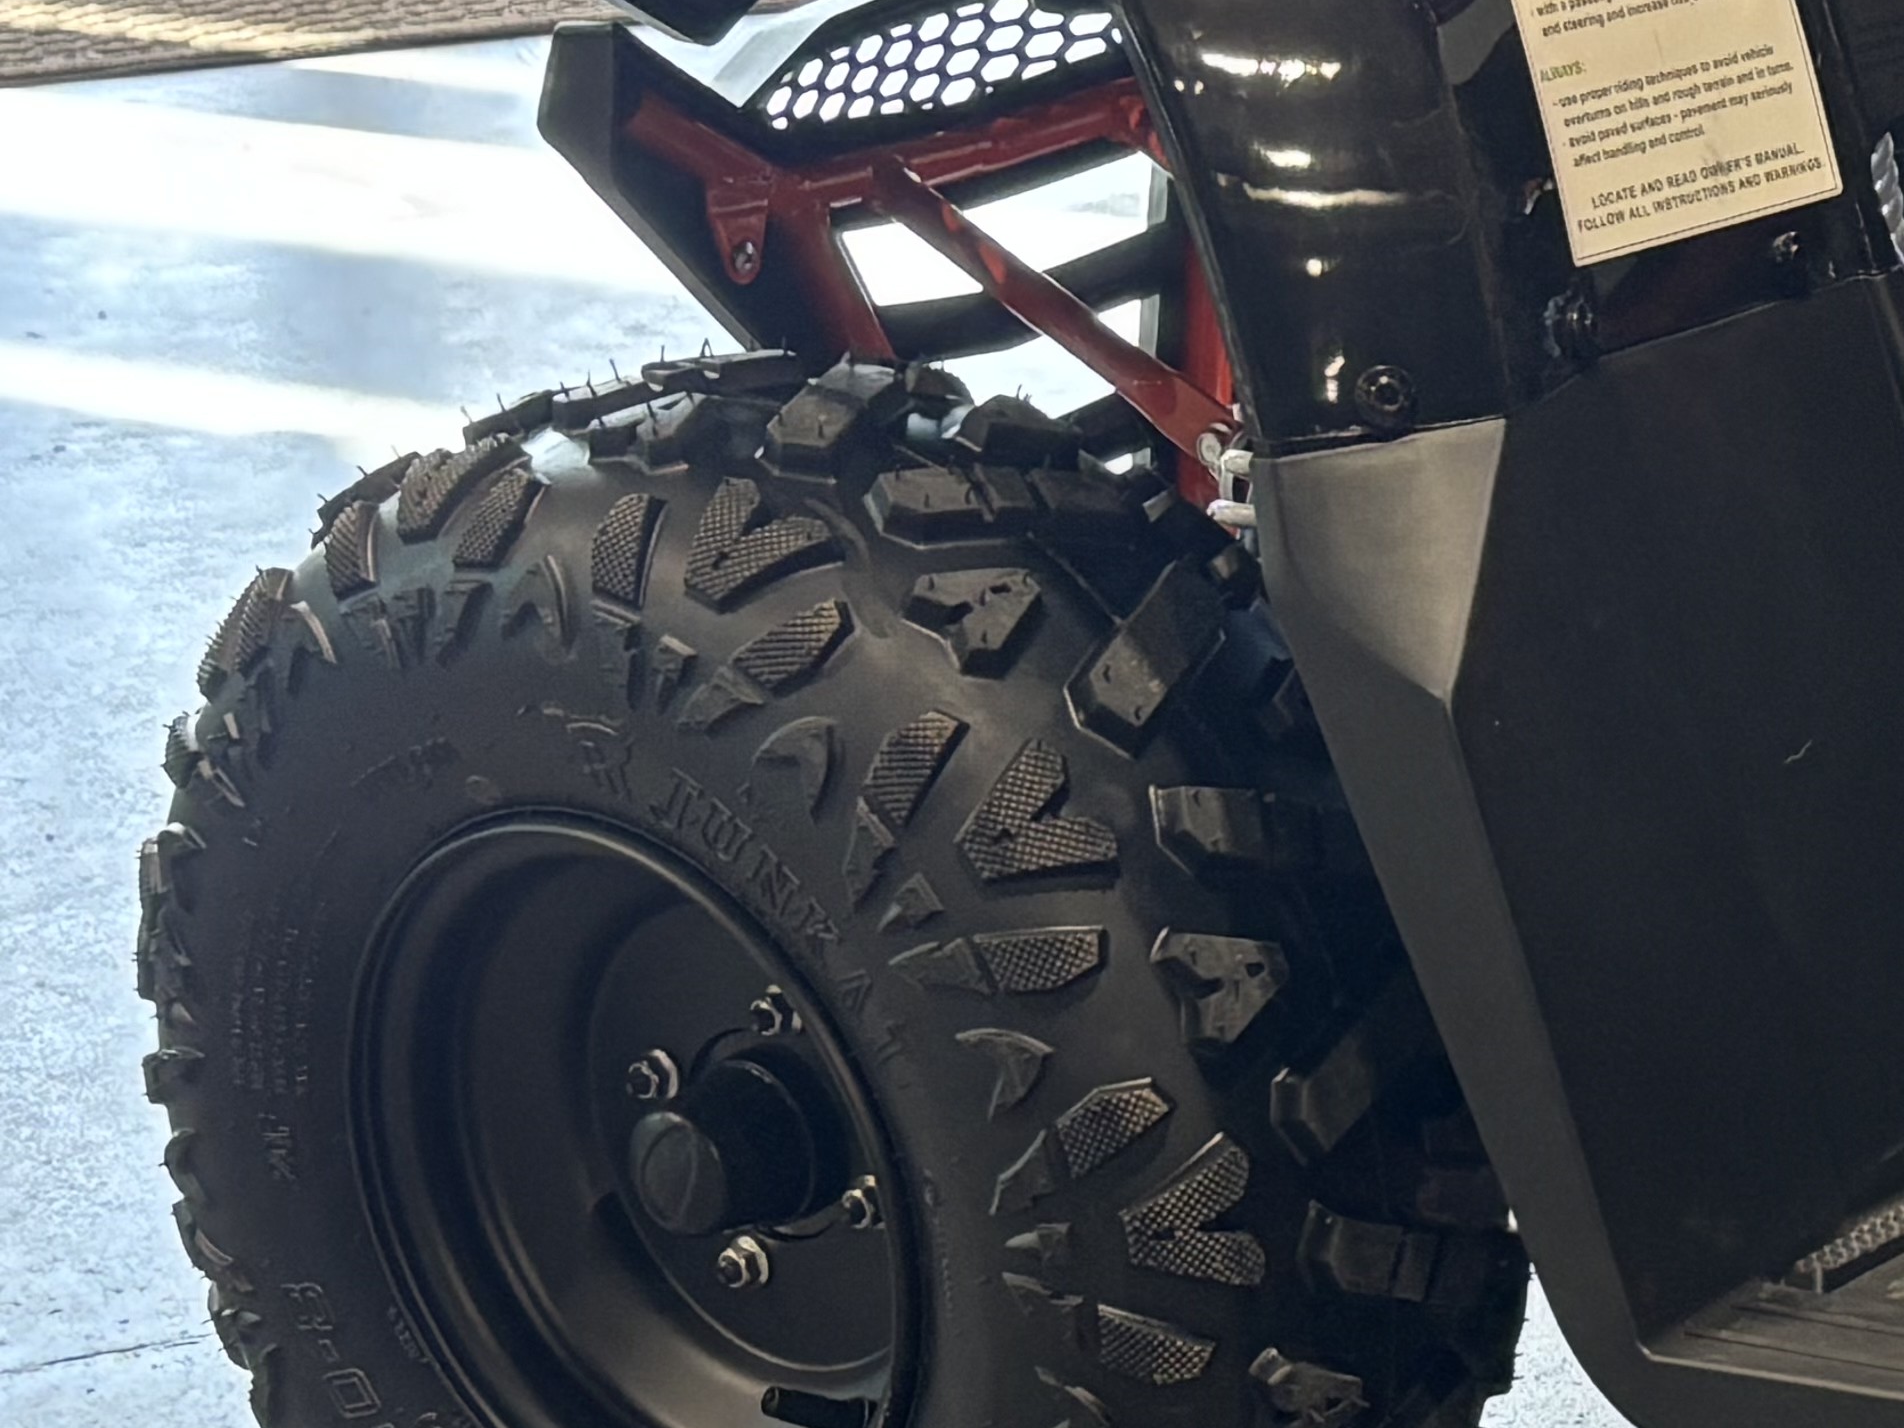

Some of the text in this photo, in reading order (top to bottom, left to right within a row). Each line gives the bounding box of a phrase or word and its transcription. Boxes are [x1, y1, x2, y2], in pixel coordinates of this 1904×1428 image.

[1576, 209, 1625, 232] FOLLOW
[1628, 204, 1651, 220] ALL
[1737, 172, 1762, 190] AND
[1590, 184, 1637, 209] LOCATE
[1639, 177, 1664, 197] AND
[1665, 168, 1698, 188] READ
